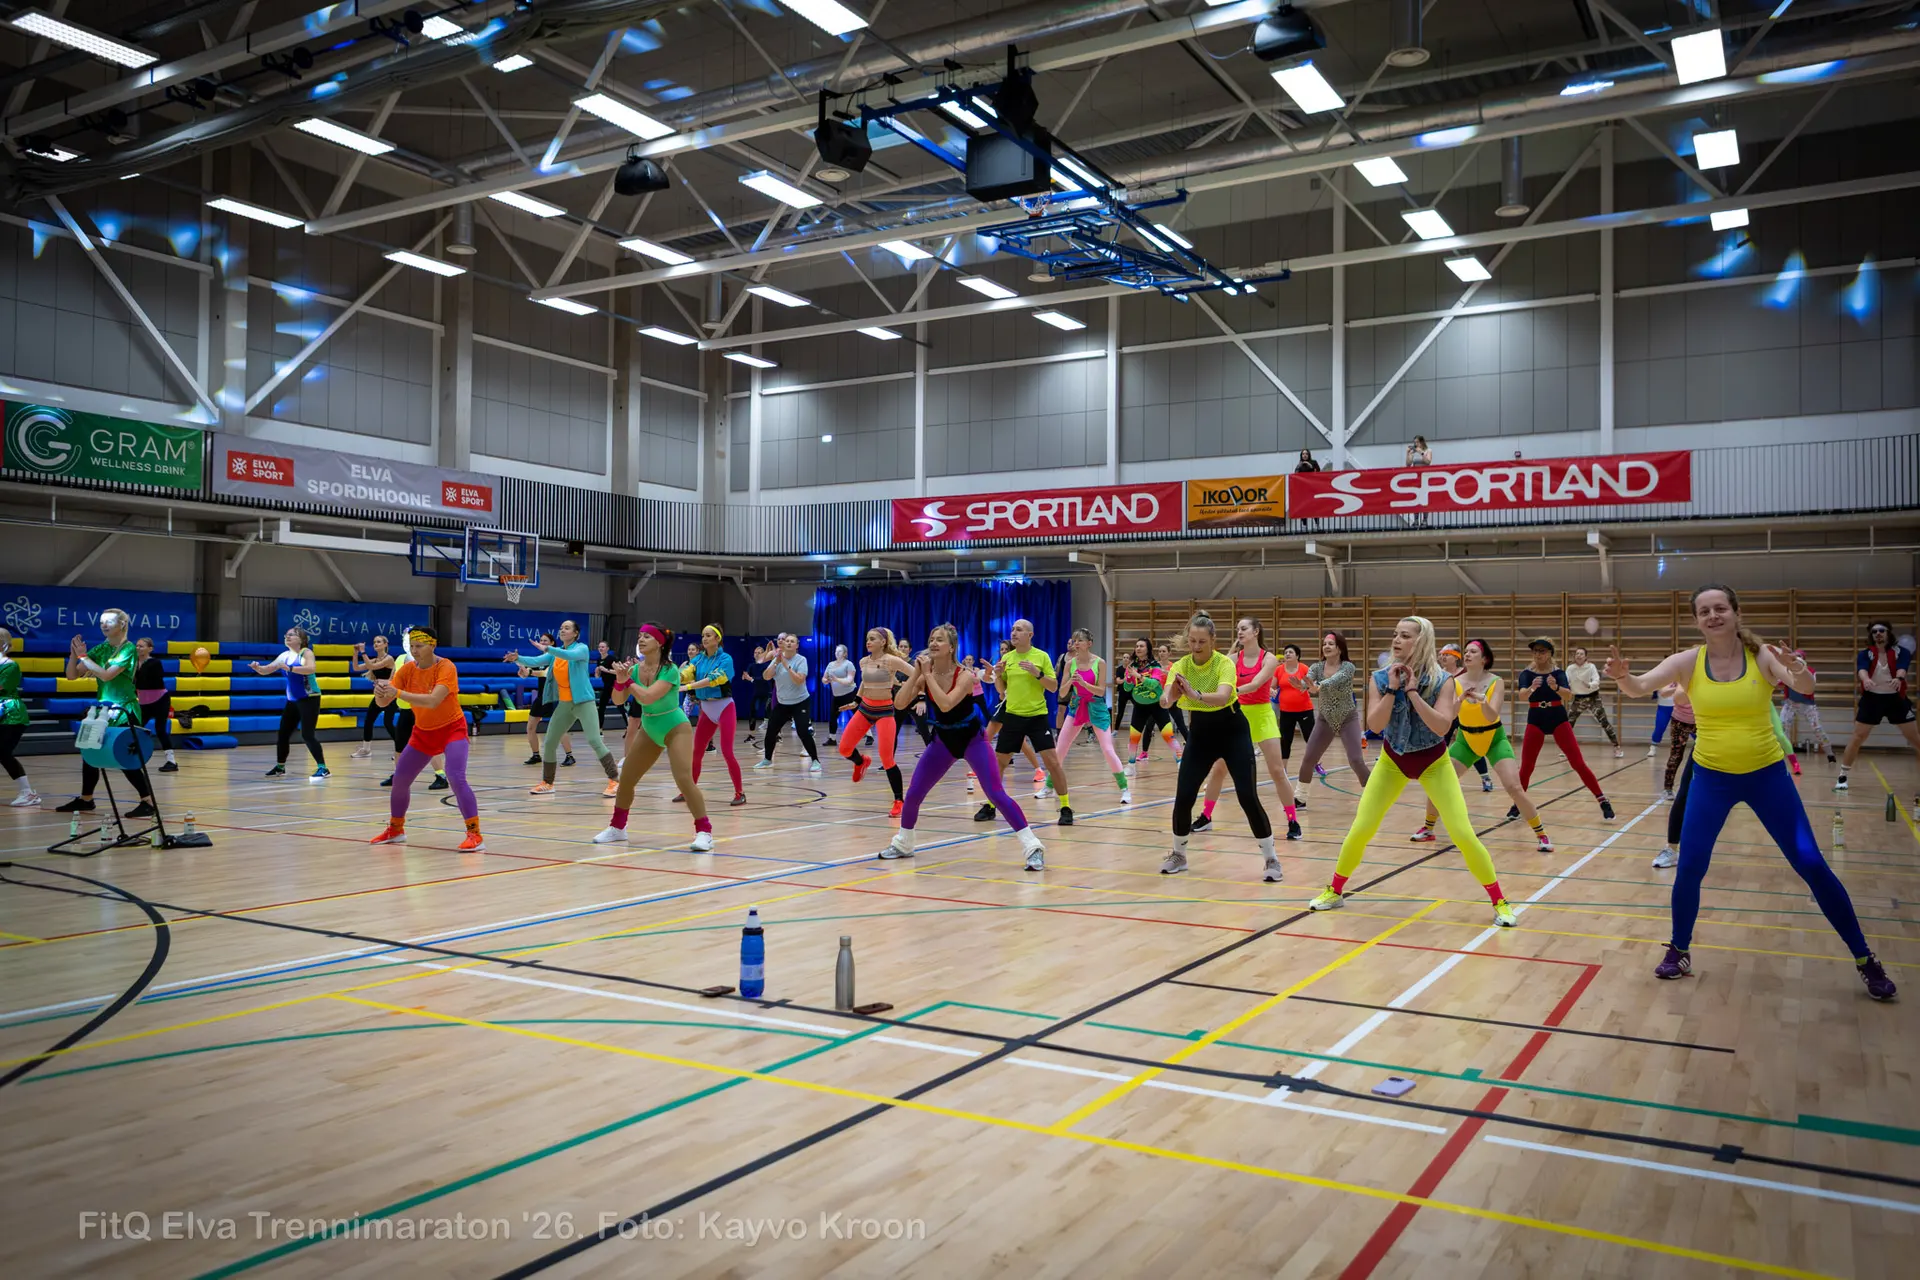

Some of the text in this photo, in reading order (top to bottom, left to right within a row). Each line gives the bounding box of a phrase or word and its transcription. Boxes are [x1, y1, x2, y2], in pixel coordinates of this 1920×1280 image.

[90, 456, 186, 476] WELLNESS DRINK
[252, 459, 276, 471] ELVA
[252, 469, 284, 480] SPORT
[350, 463, 393, 483] ELVA
[307, 479, 431, 508] SPORDIHOONE
[460, 488, 478, 498] ELVA
[1390, 460, 1659, 508] SPORTLAND
[460, 496, 484, 507] SPORT
[1203, 485, 1268, 506] IKODOR
[965, 492, 1160, 532] SPORTLAND
[57, 606, 101, 627] ELV
[328, 617, 369, 634] ELVA
[509, 624, 540, 639] ELVA
